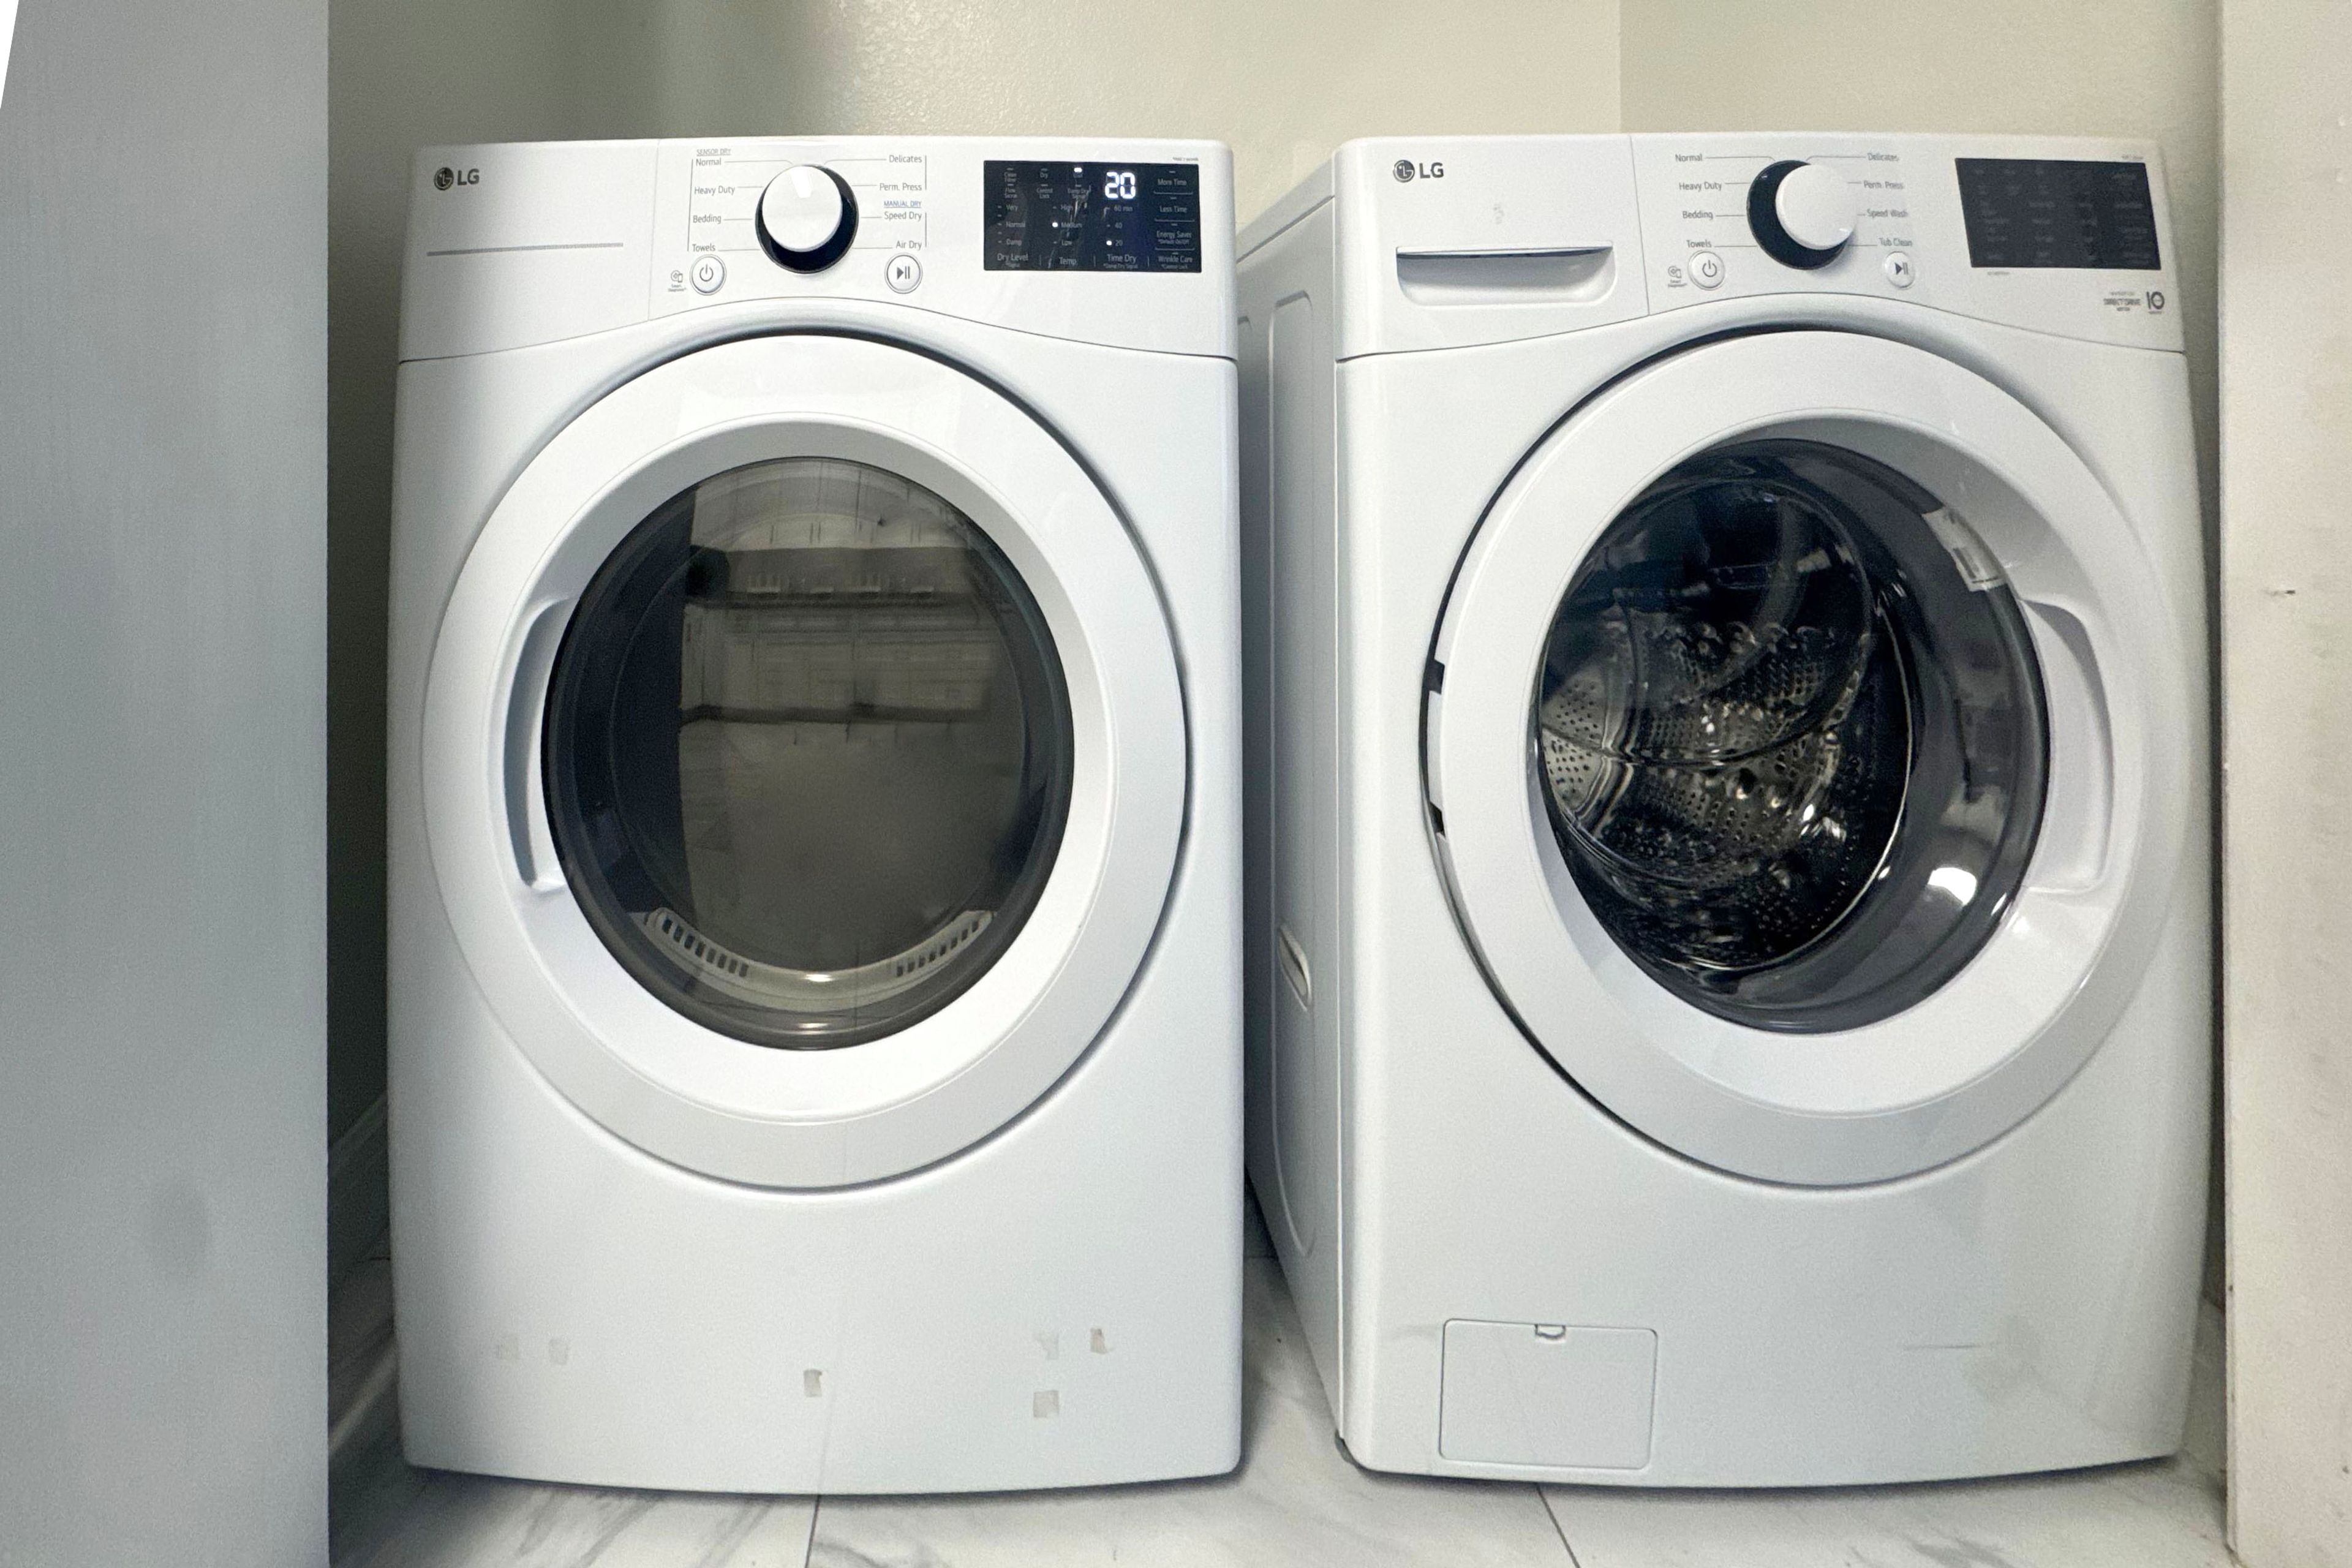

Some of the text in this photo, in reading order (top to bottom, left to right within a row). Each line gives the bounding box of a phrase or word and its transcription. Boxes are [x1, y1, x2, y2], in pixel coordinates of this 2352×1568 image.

[696, 157, 722, 166] Normal
[889, 154, 922, 163] Delicates
[1675, 153, 1703, 162] Normal
[1419, 162, 1444, 179] LG
[457, 168, 480, 186] LG
[880, 183, 922, 191] Perm. Press
[1104, 172, 1136, 199] 20
[1679, 181, 1722, 192] Heavy Duty
[695, 186, 735, 196] Heavy Duty
[884, 211, 922, 222] Speed Dry
[1683, 210, 1713, 221] Bedding
[1866, 208, 1888, 219] Speed
[693, 214, 722, 224] Bedding
[692, 243, 716, 252] Towels
[909, 240, 922, 251] Dry
[1686, 239, 1712, 247] Towels
[997, 253, 1009, 262] Dry
[1124, 254, 1137, 264] Dry
